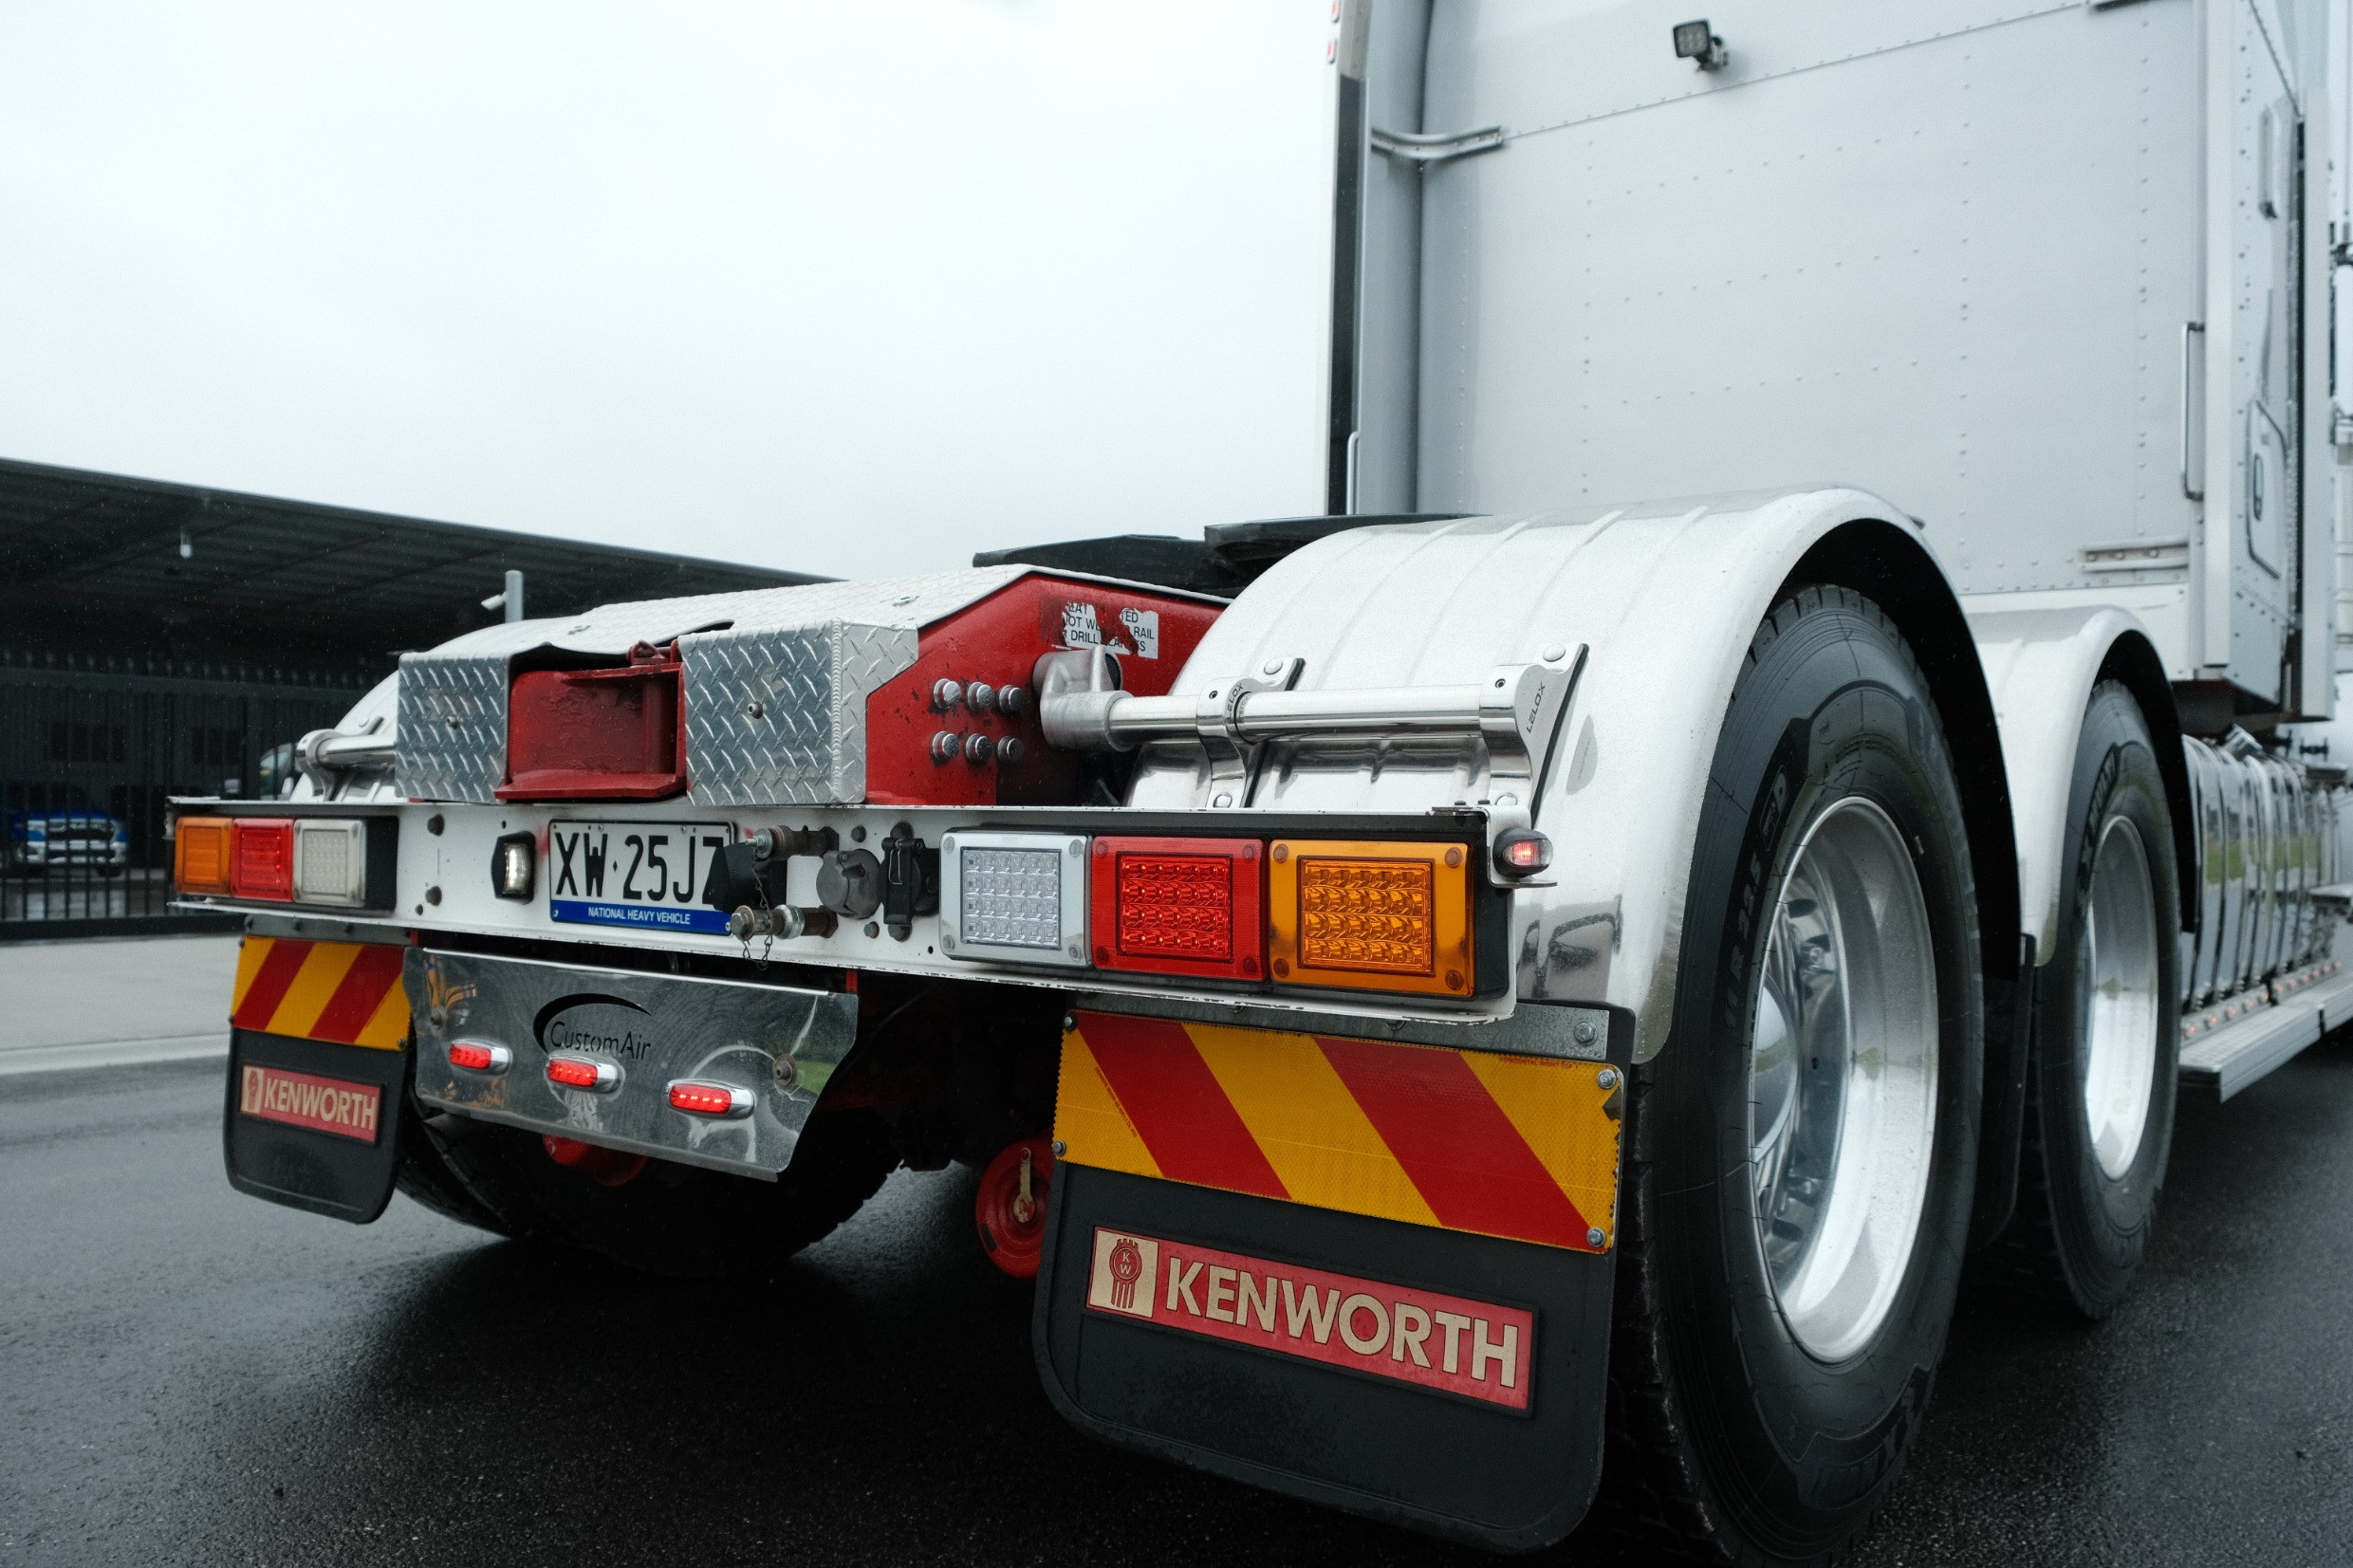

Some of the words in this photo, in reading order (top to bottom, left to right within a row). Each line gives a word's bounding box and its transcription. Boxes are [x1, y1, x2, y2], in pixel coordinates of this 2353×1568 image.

[1070, 630, 1100, 645] DRILL
[1134, 627, 1156, 640] RAIL
[588, 907, 626, 920] NATIONAL
[627, 910, 656, 922] HEAVY
[656, 912, 691, 925] VEHICLE
[549, 1020, 652, 1061] CustomAir
[264, 1077, 377, 1132] KENWORTH
[1122, 1251, 1131, 1264] K
[1120, 1263, 1132, 1275] W
[1165, 1255, 1519, 1390] KENWORTH
